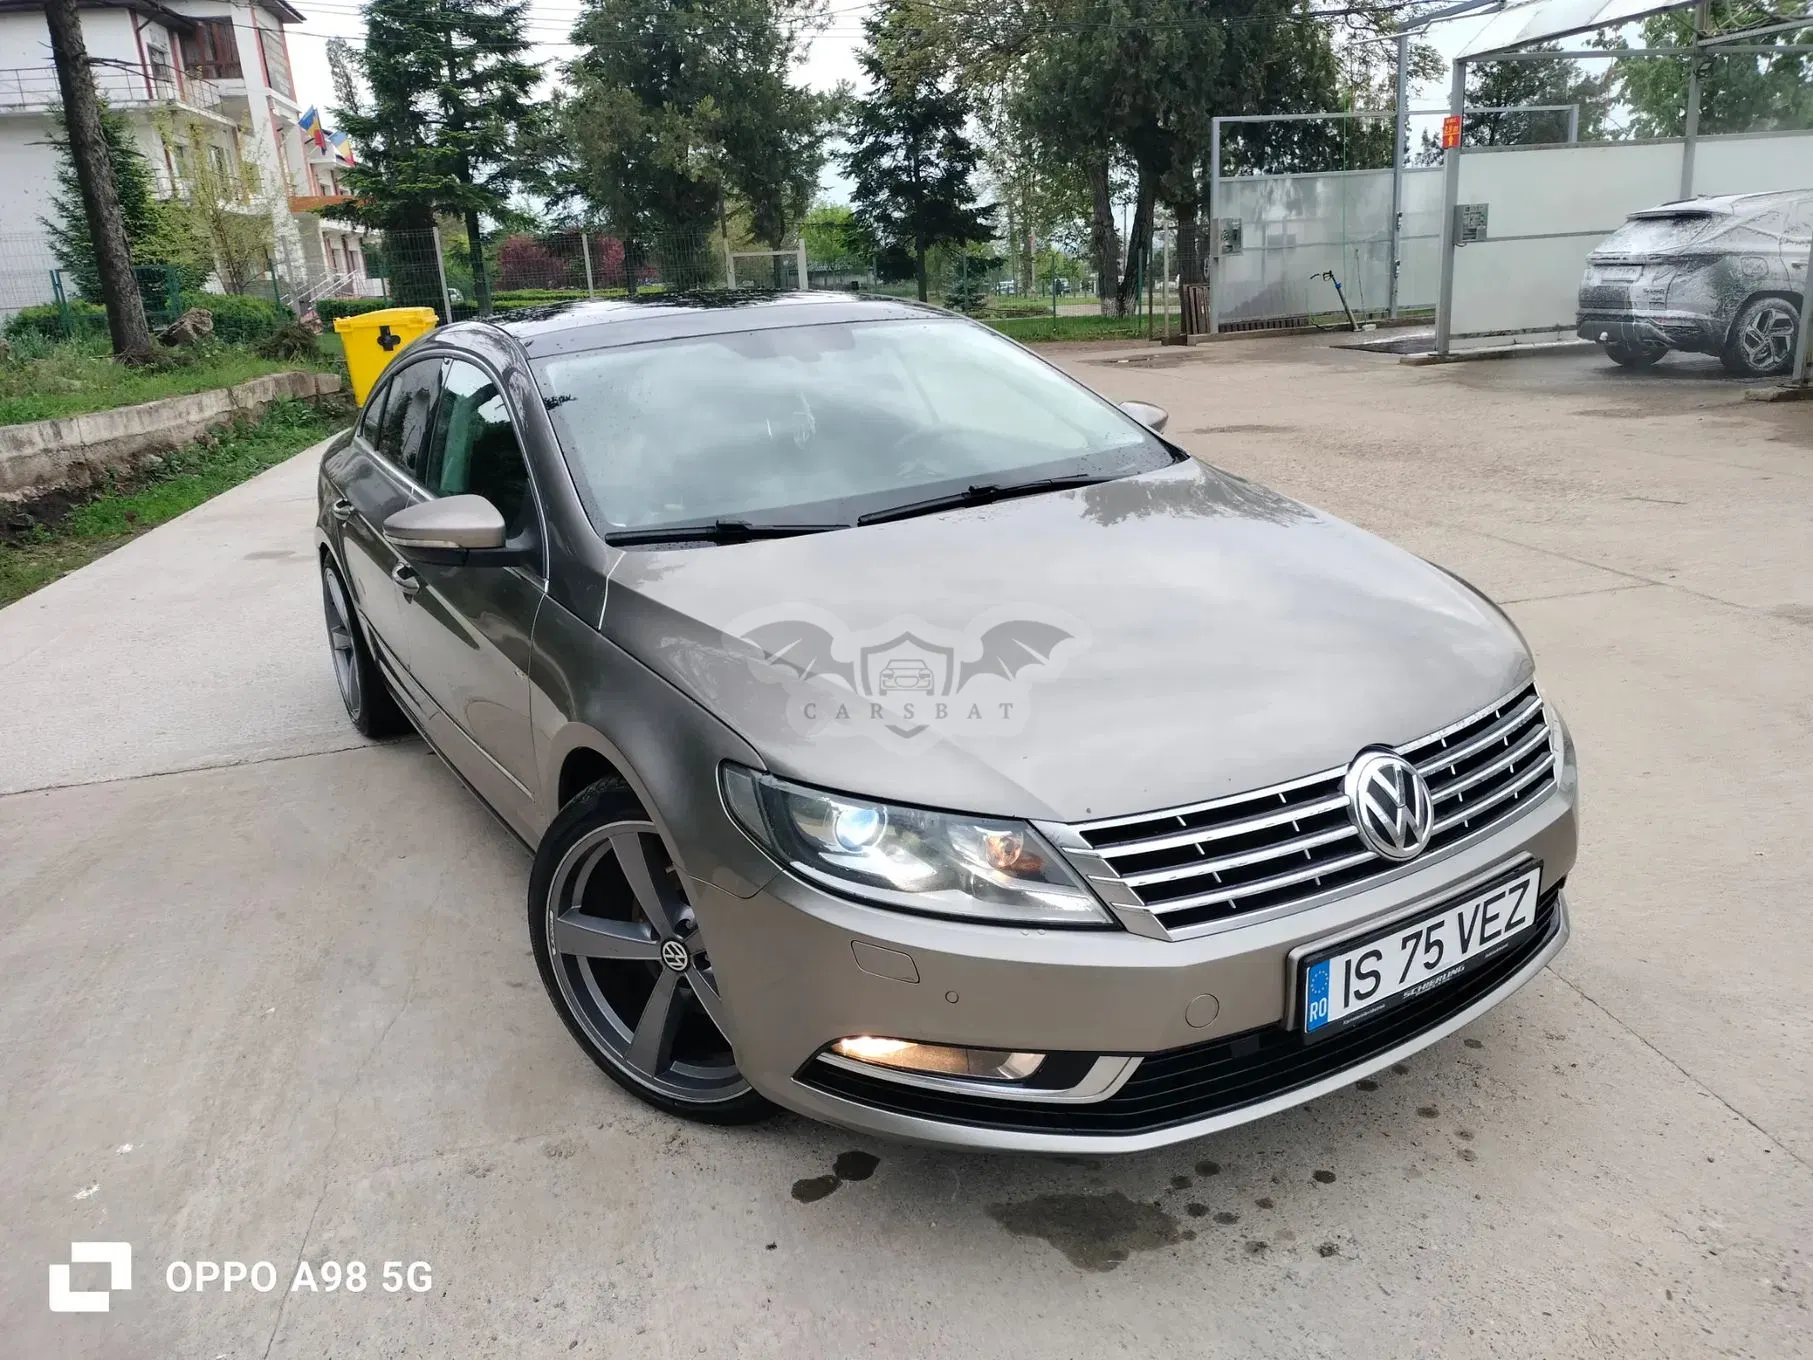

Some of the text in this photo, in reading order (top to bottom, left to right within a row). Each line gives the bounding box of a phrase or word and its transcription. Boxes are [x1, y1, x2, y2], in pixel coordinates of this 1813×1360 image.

[1343, 879, 1531, 1009] IS 75 VEZ
[1309, 997, 1327, 1023] RO
